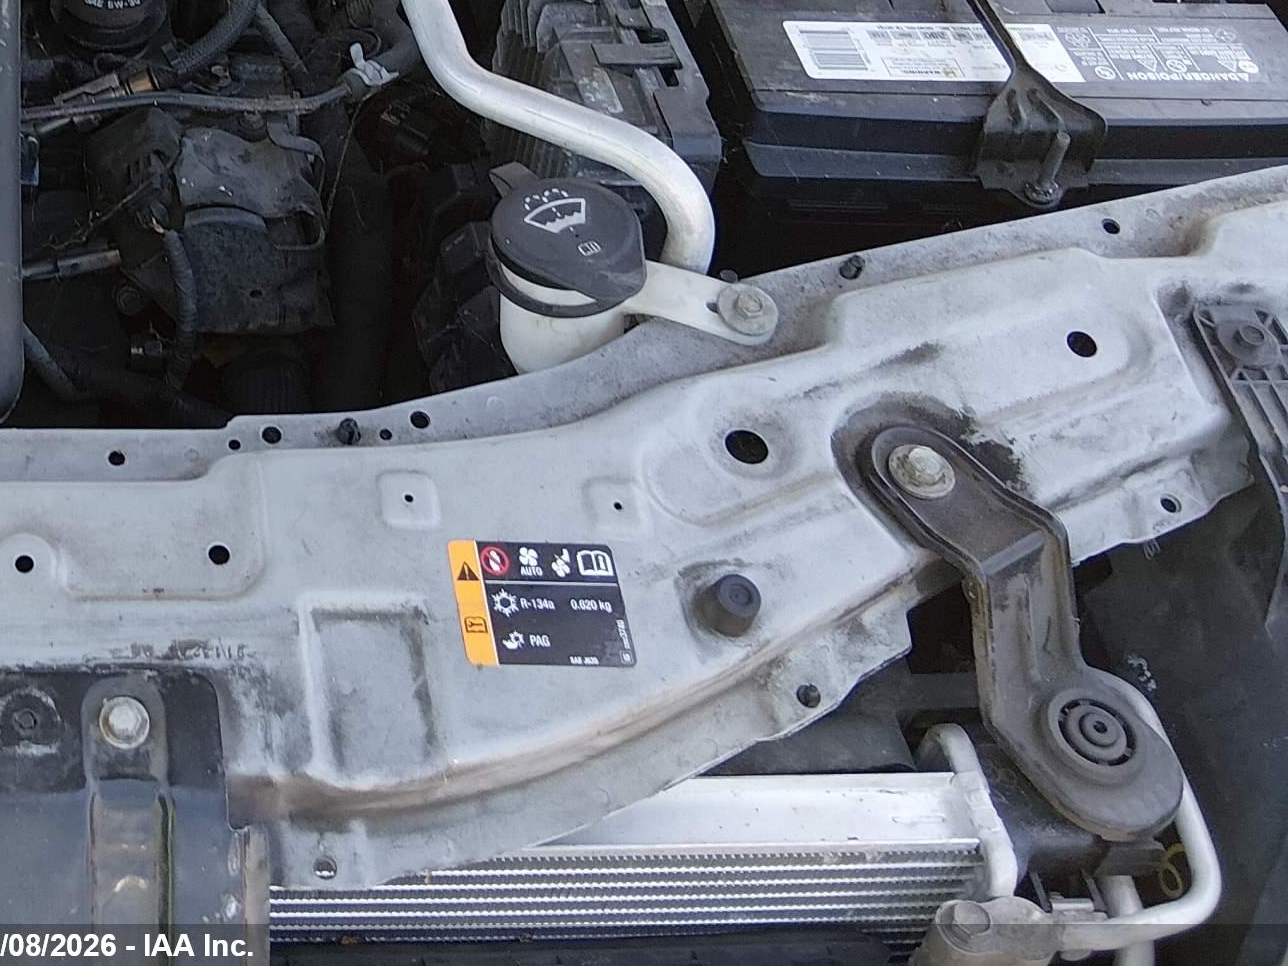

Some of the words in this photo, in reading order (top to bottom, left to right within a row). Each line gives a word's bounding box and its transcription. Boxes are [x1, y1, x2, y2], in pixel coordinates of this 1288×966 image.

[520, 566, 543, 577] AUTO
[520, 597, 556, 611] R-134a
[570, 598, 599, 611] 0.620
[599, 597, 613, 614] kg
[529, 634, 551, 648] PAG
